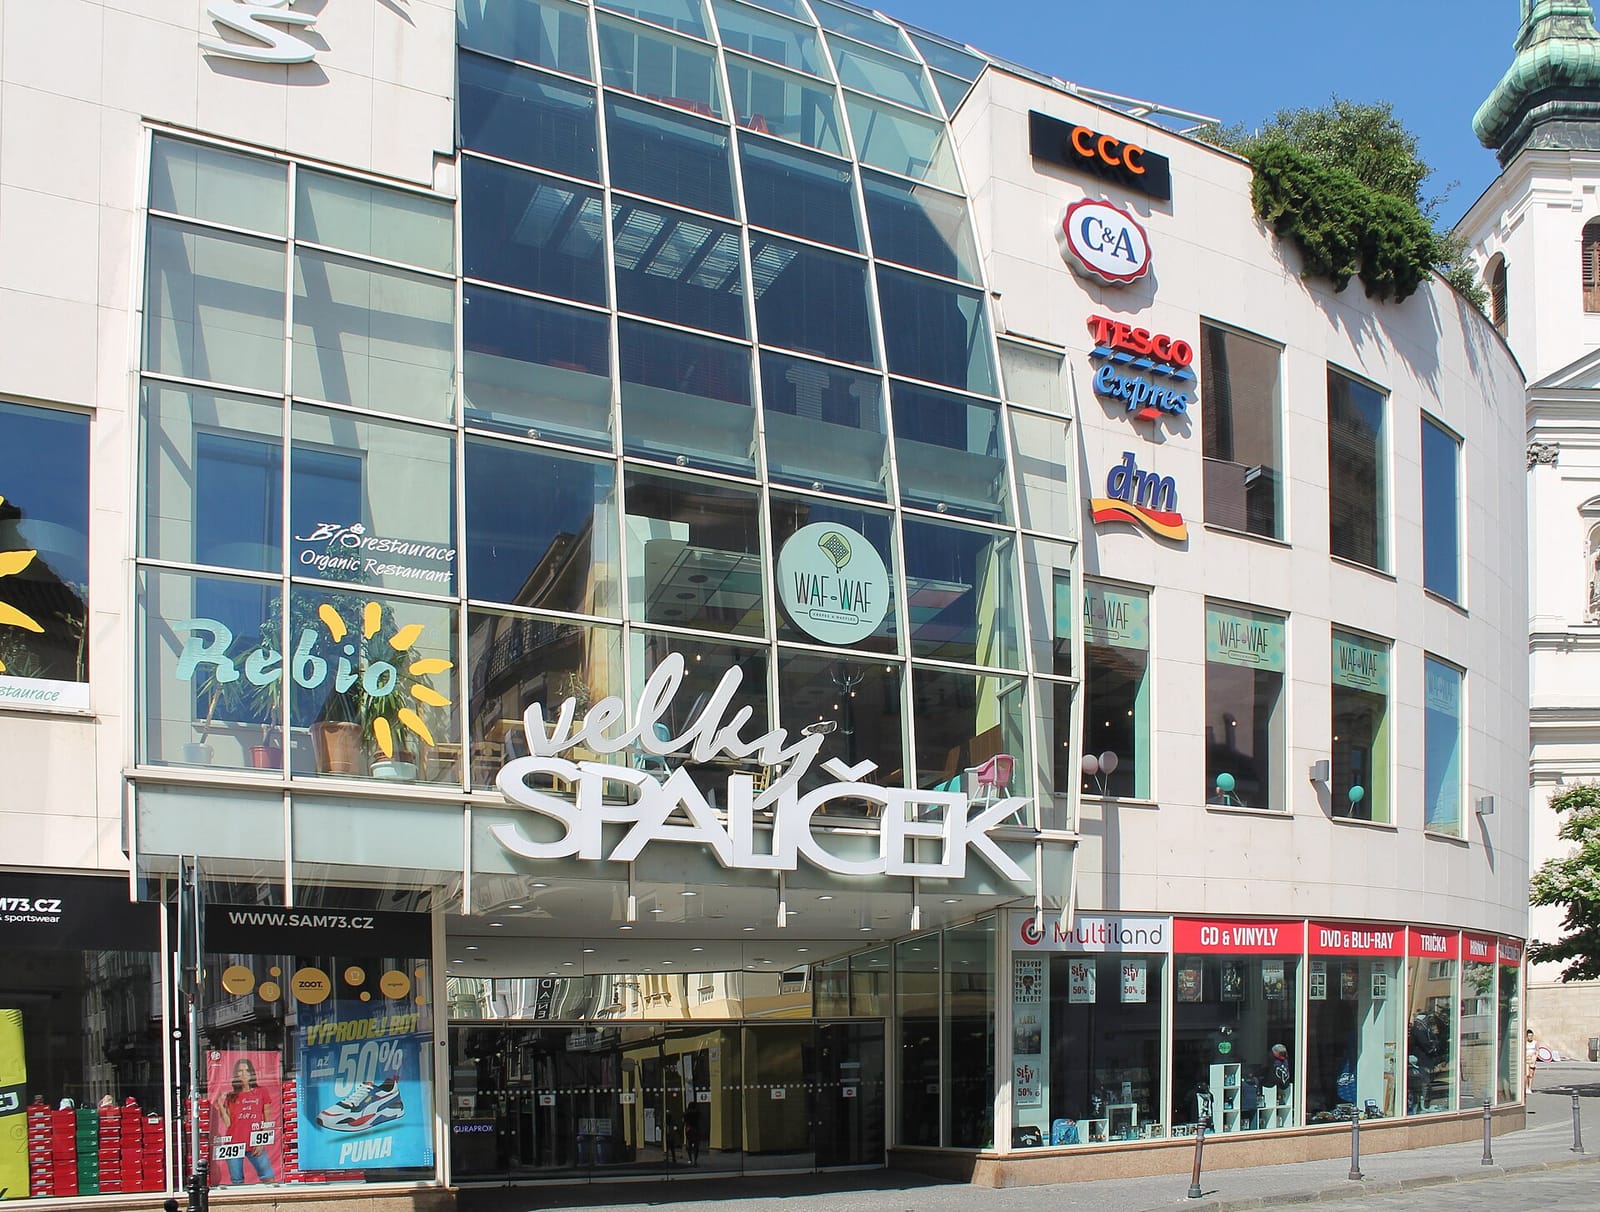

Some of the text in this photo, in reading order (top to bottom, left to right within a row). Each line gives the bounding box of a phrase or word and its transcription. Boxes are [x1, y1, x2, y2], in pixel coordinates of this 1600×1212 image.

[1072, 126, 1146, 175] CCC
[1081, 216, 1138, 264] C&A
[1087, 314, 1193, 367] TESCO
[1093, 364, 1189, 416] expres
[1107, 451, 1176, 511] dm
[300, 550, 453, 582] Organic Restaurant
[1084, 596, 1130, 630] AF-WAF
[172, 617, 397, 696] Rebio
[523, 652, 837, 810] velký
[4, 914, 61, 923] sportswear
[228, 911, 374, 929] WWW.SAM73.CZ
[1054, 921, 1162, 944] Multiland
[1201, 926, 1279, 946] CD & VINYLY
[1320, 929, 1394, 949] DVD & BLU-RAY
[1420, 933, 1447, 953] TRIČKA
[1073, 986, 1087, 994] 50%
[1124, 986, 1138, 994] 50%
[307, 1013, 420, 1046] VÝPRODEJ BOT
[1017, 1087, 1032, 1097] 50%
[256, 1132, 269, 1144] 99
[453, 1125, 493, 1133] CURAPROX
[219, 1146, 239, 1159] 249
[339, 1136, 392, 1165] PUMA
